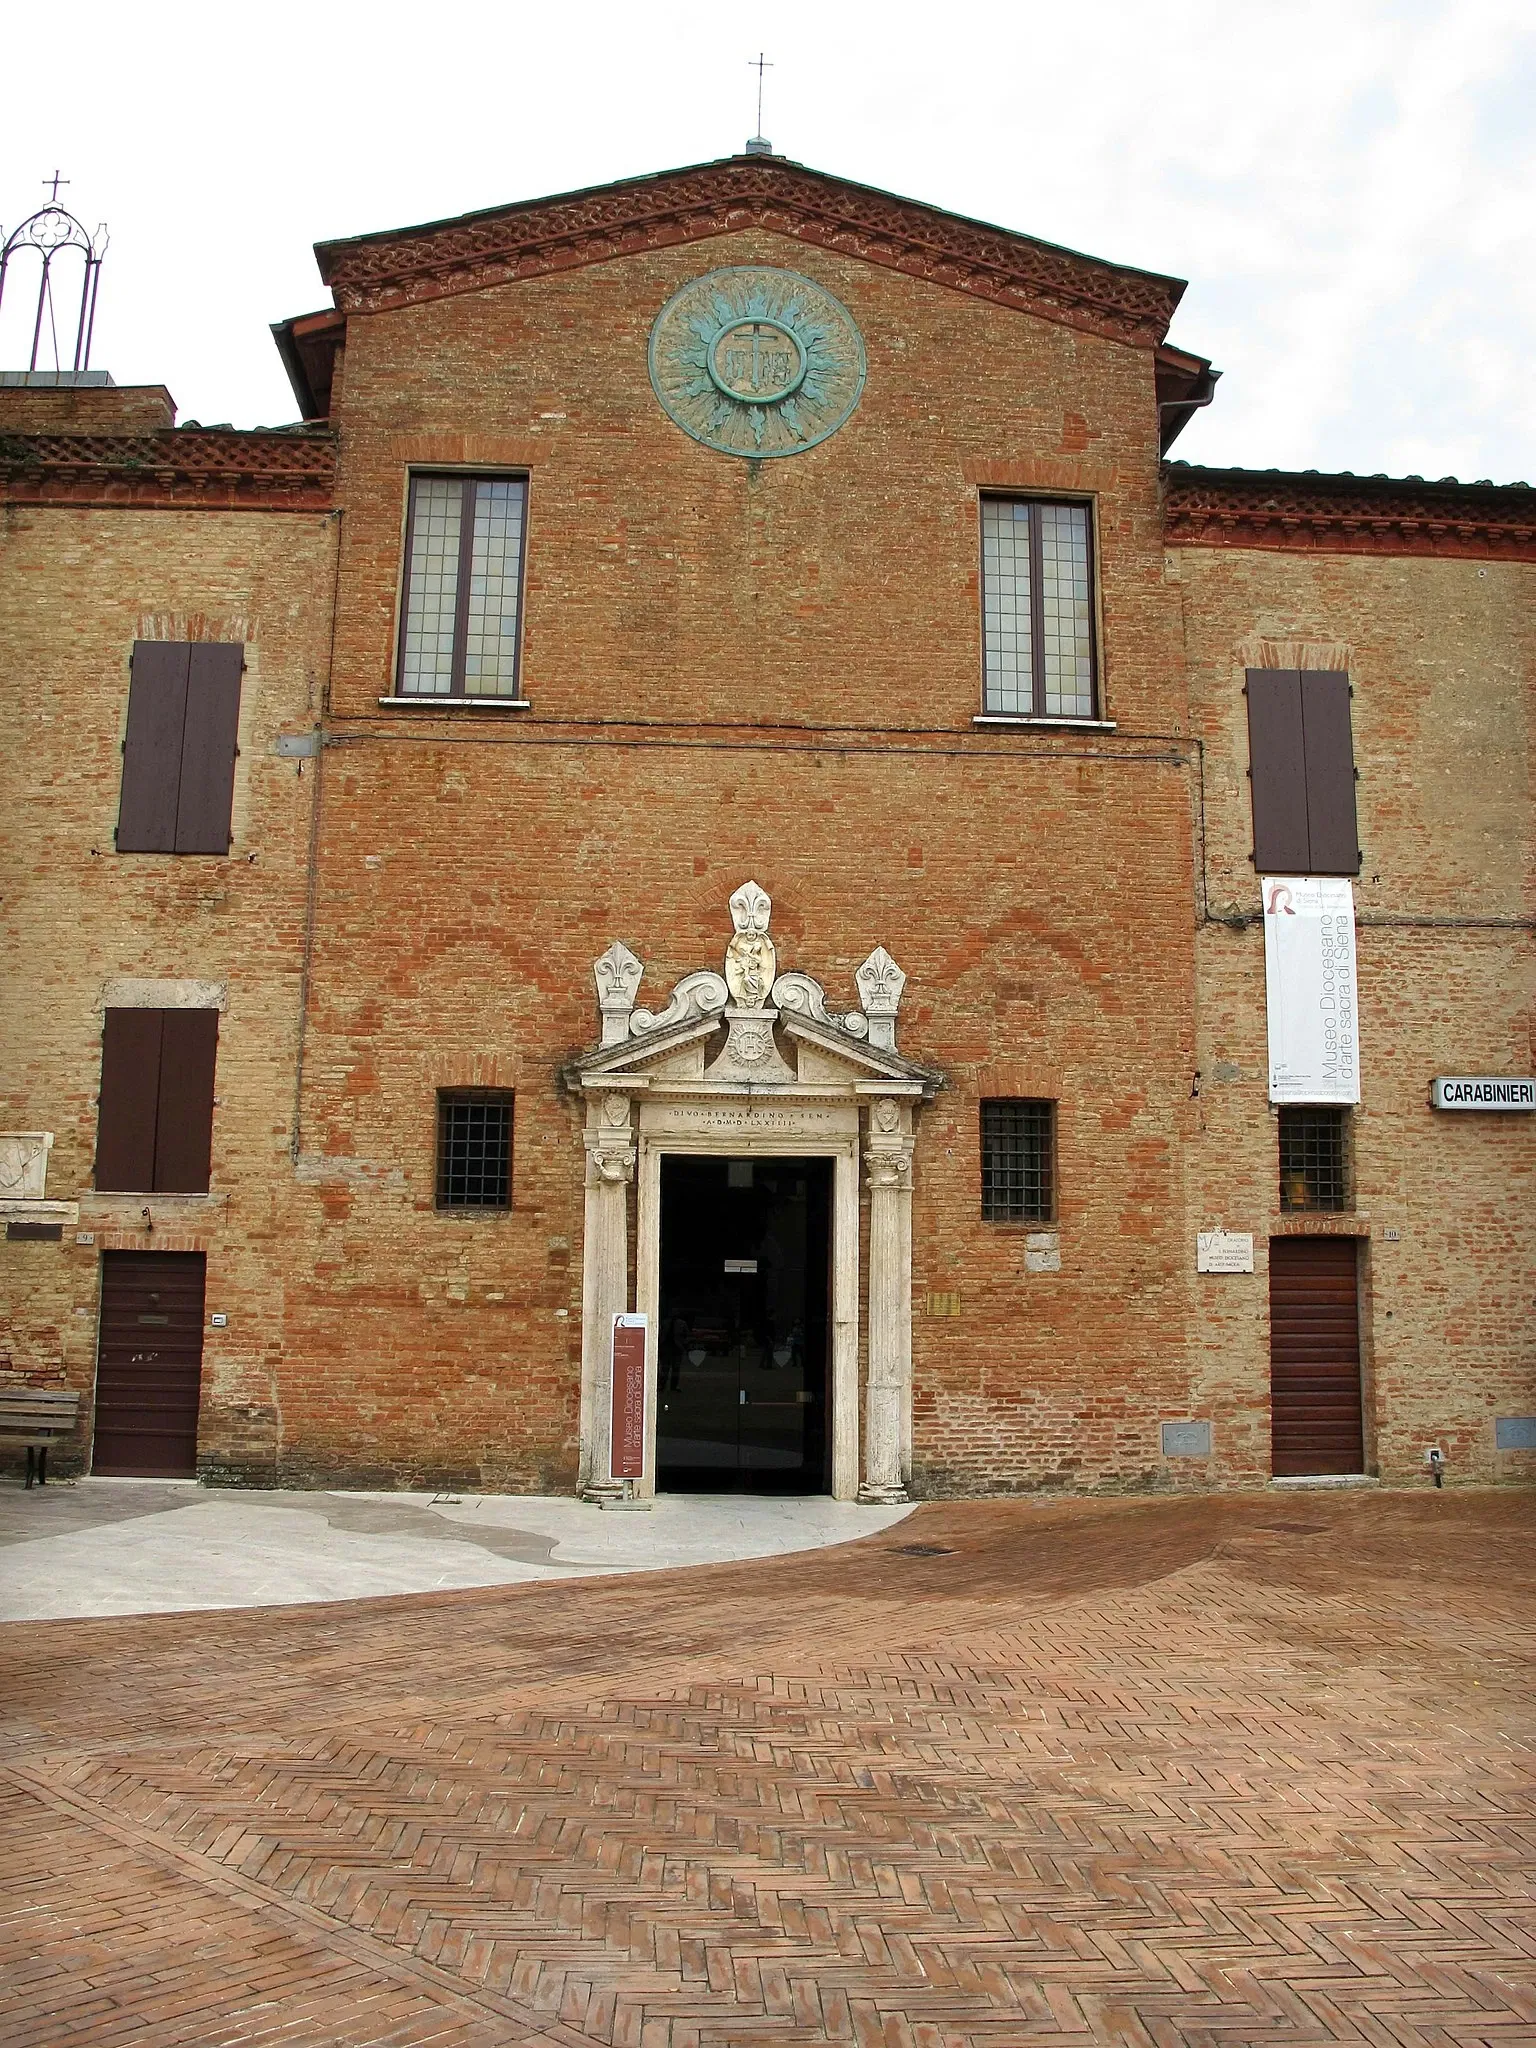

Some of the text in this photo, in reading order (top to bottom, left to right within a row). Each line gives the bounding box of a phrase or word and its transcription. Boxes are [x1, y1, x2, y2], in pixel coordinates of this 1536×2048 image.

[1333, 915, 1350, 960] Siena
[1335, 965, 1350, 979] di
[1320, 914, 1337, 1080] Museo Diocesano
[1338, 984, 1352, 1029] sacra
[1337, 1033, 1354, 1080] d'arte
[1443, 1083, 1534, 1103] CARABINIERI
[623, 1365, 634, 1414] Diocesano
[623, 1416, 634, 1448] Museo
